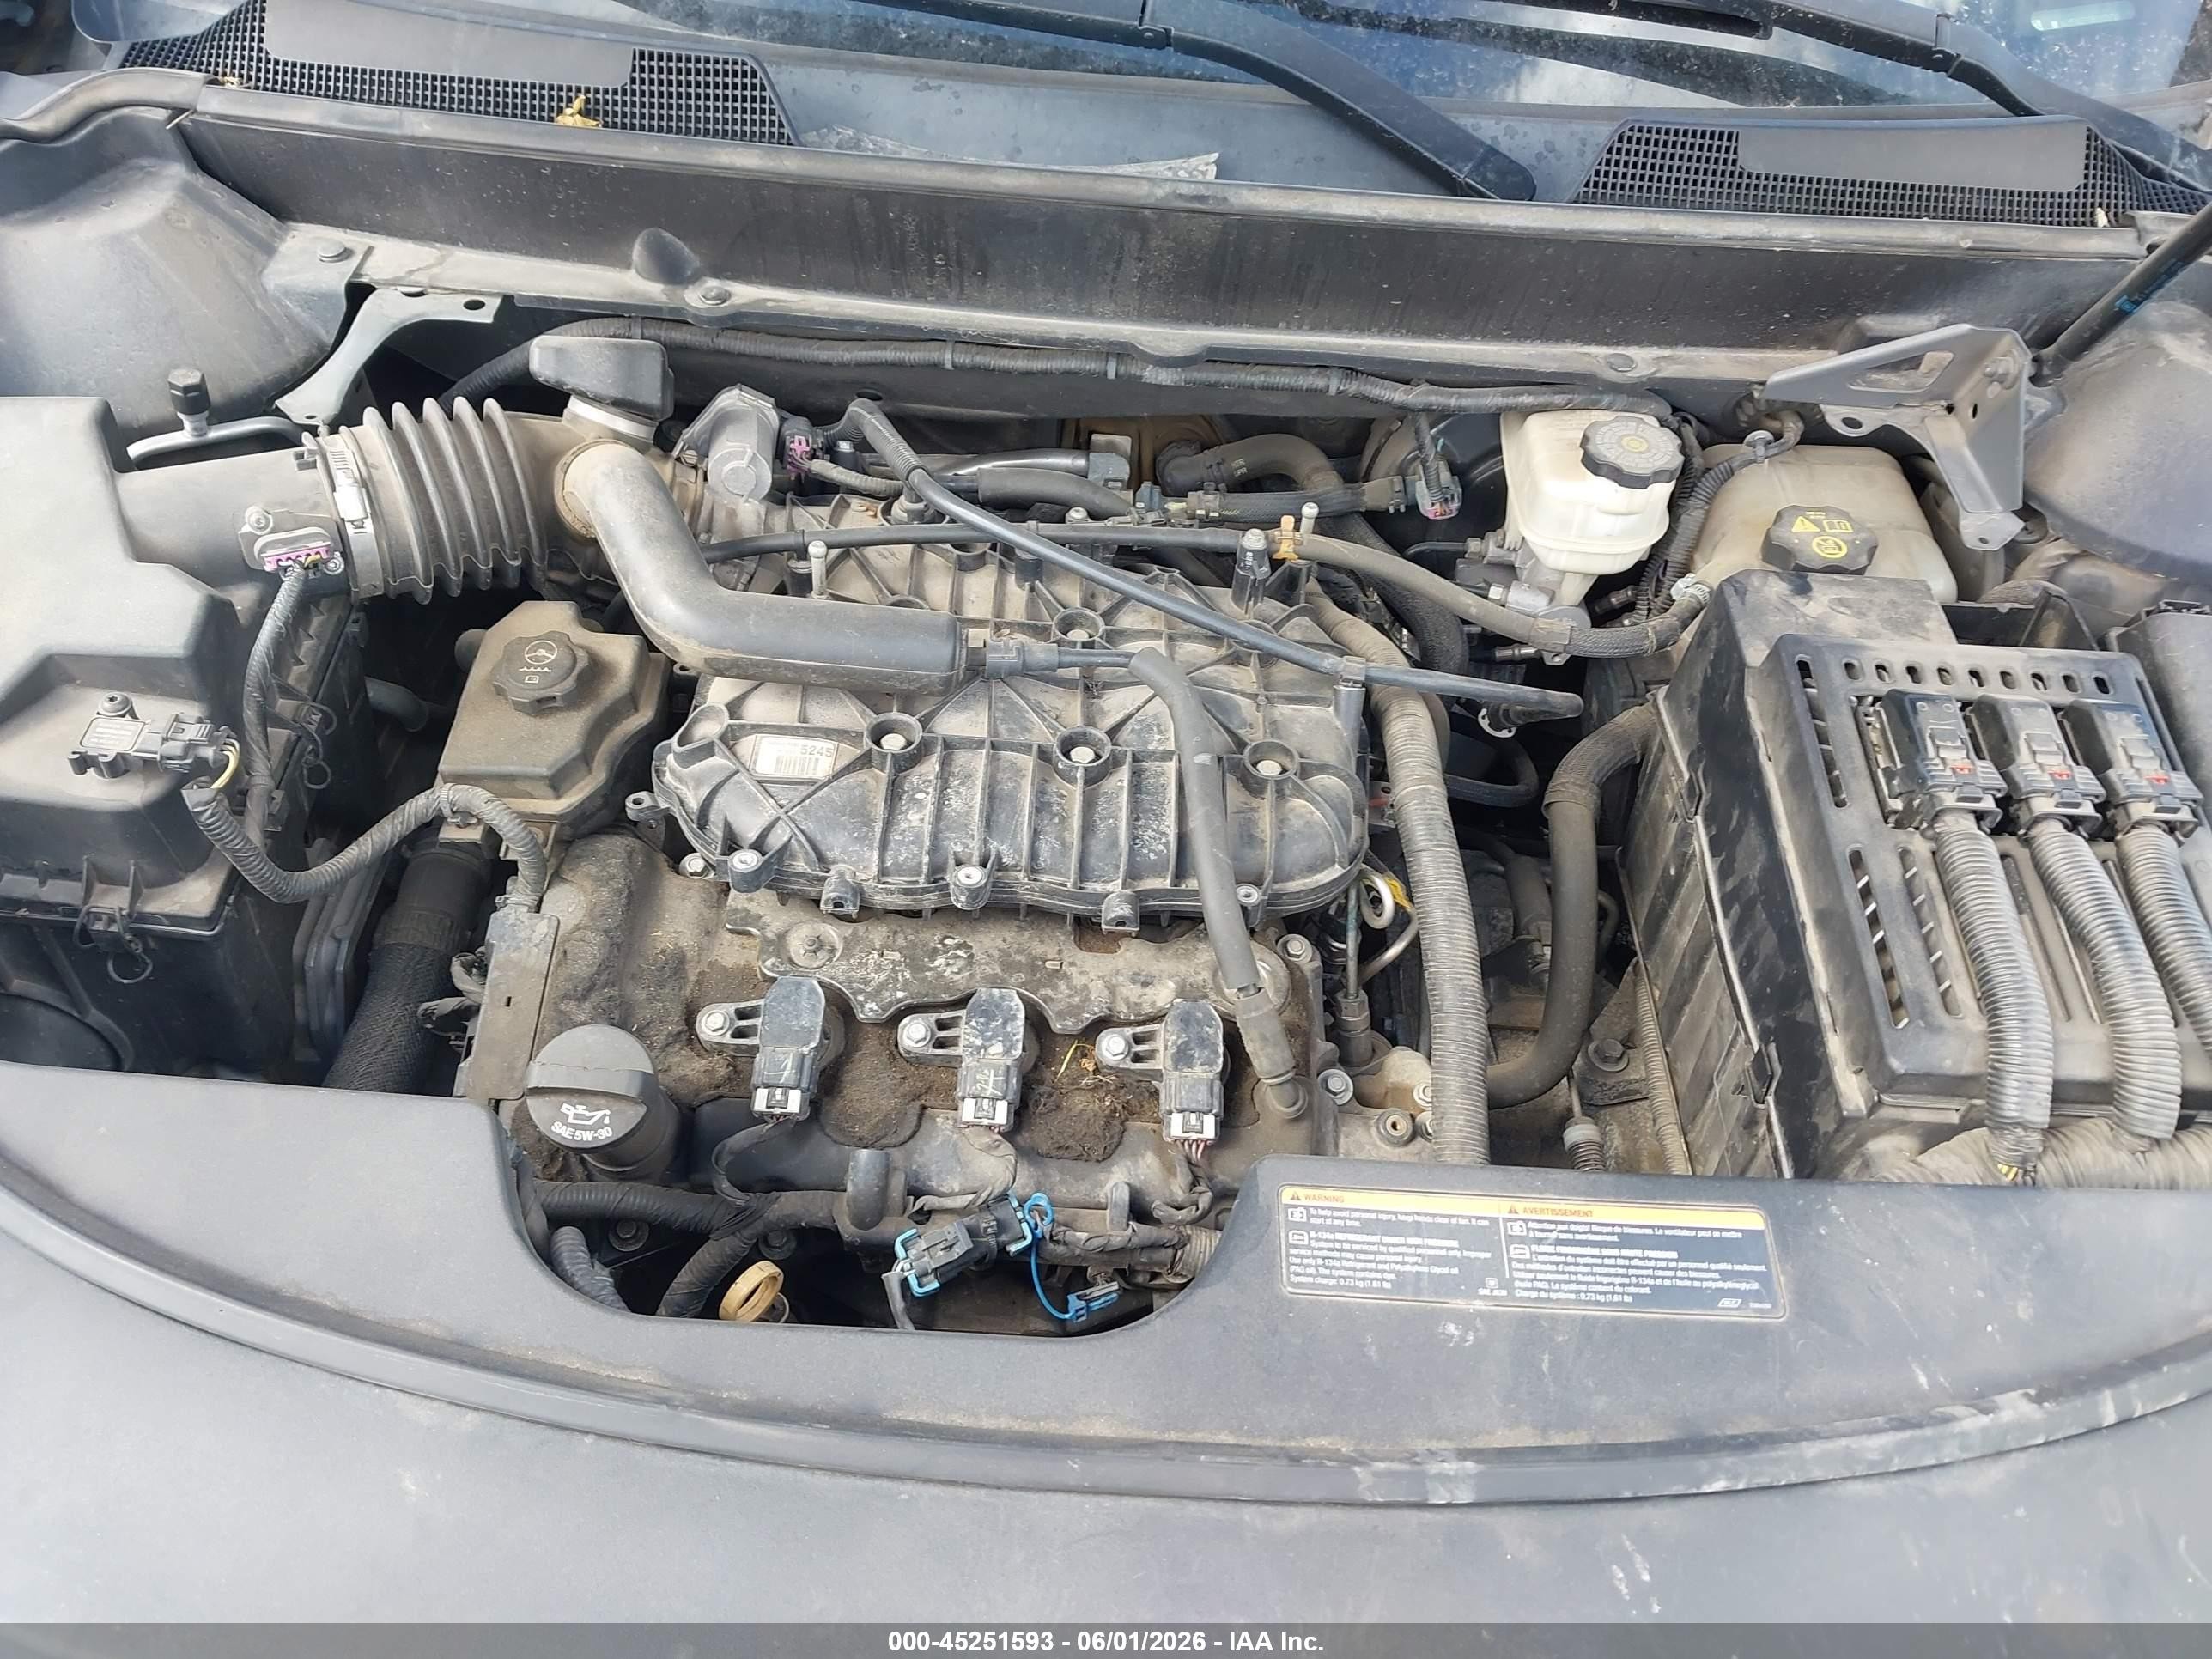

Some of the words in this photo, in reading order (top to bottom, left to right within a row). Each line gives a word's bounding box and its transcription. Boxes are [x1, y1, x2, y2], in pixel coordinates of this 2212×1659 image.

[800, 744, 834, 757] 5245
[550, 1121, 575, 1139] SAE
[573, 1127, 612, 1141] 5W-30
[1304, 1194, 1345, 1203] WARNING
[1523, 1208, 1593, 1218] AVERTISSEMENT
